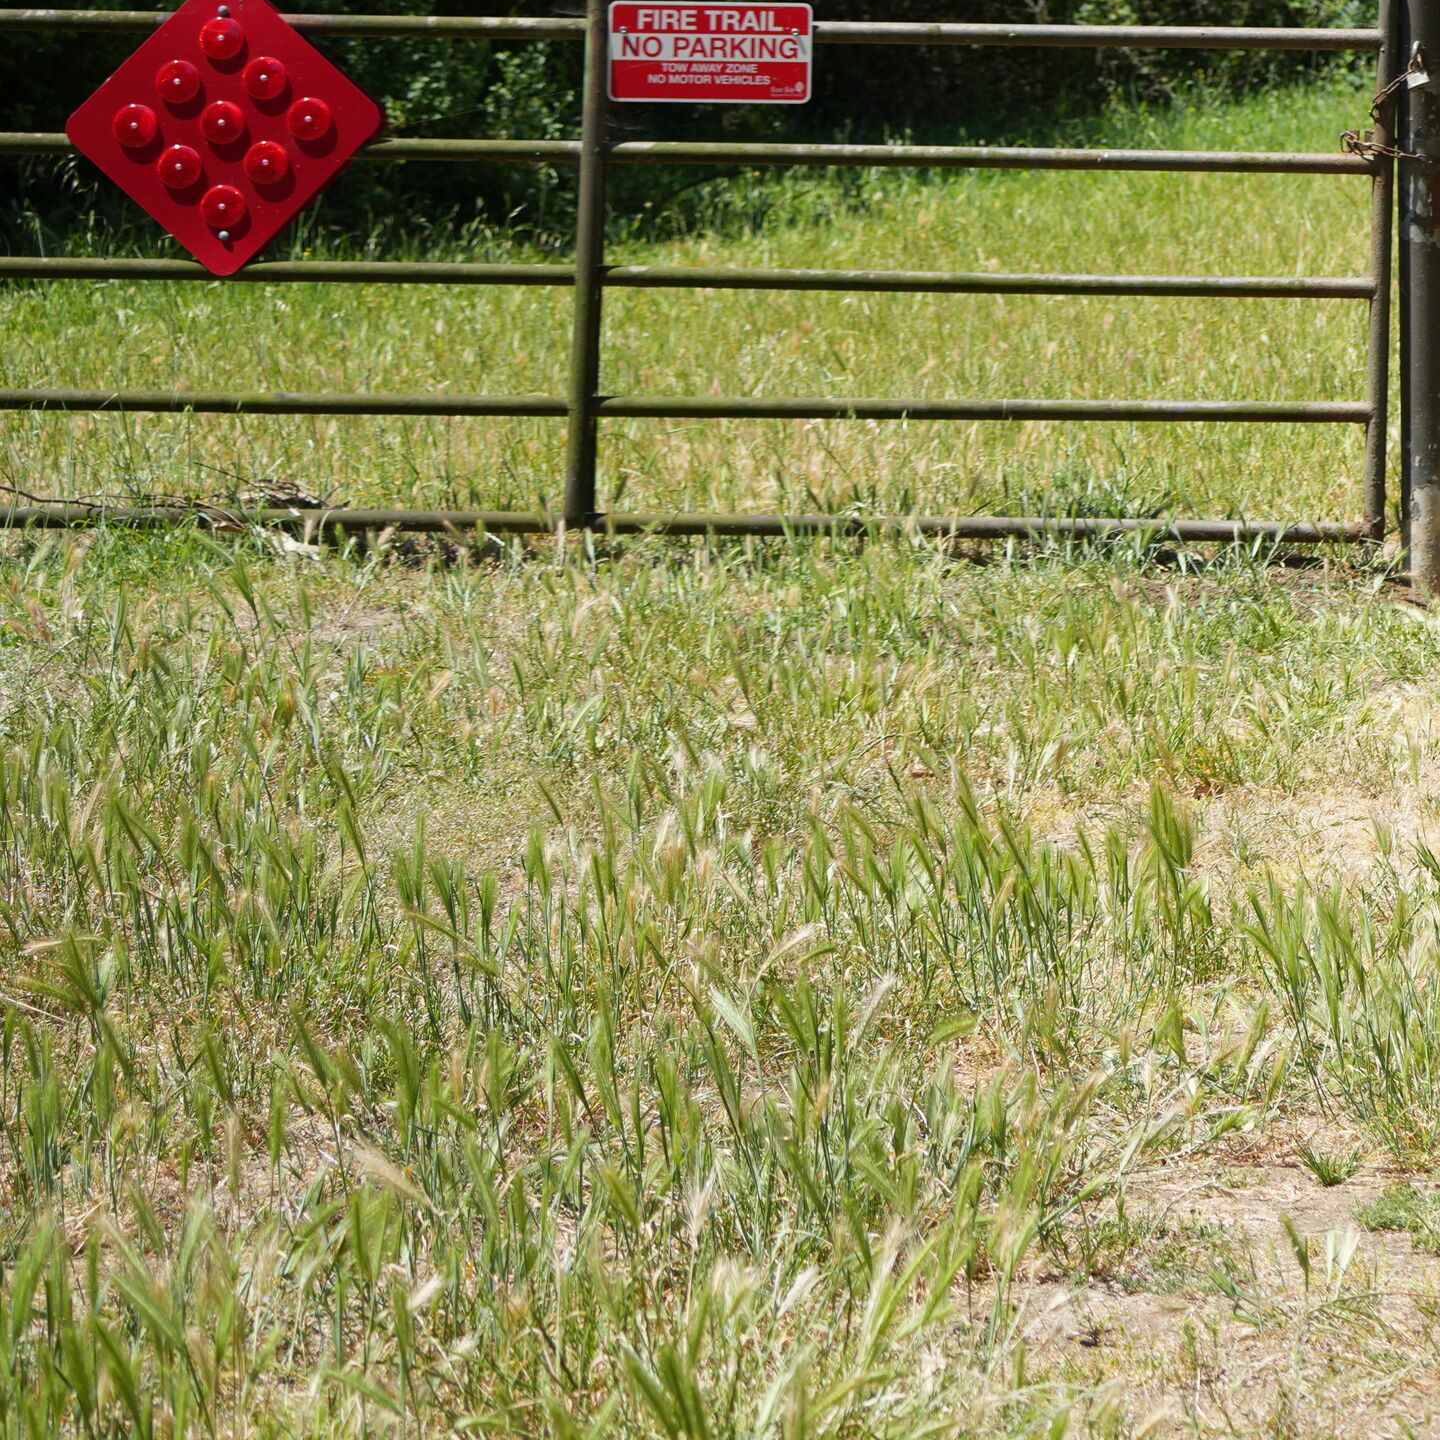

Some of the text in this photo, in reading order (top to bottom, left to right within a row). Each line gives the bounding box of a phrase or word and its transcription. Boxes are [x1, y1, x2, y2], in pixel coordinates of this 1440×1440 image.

[637, 9, 783, 32] FIRE TRAIL
[621, 36, 798, 59] NO PARKING
[661, 62, 758, 73] TOW AWAY ZONE
[647, 74, 771, 85] NO MOTOR VEHICLES
